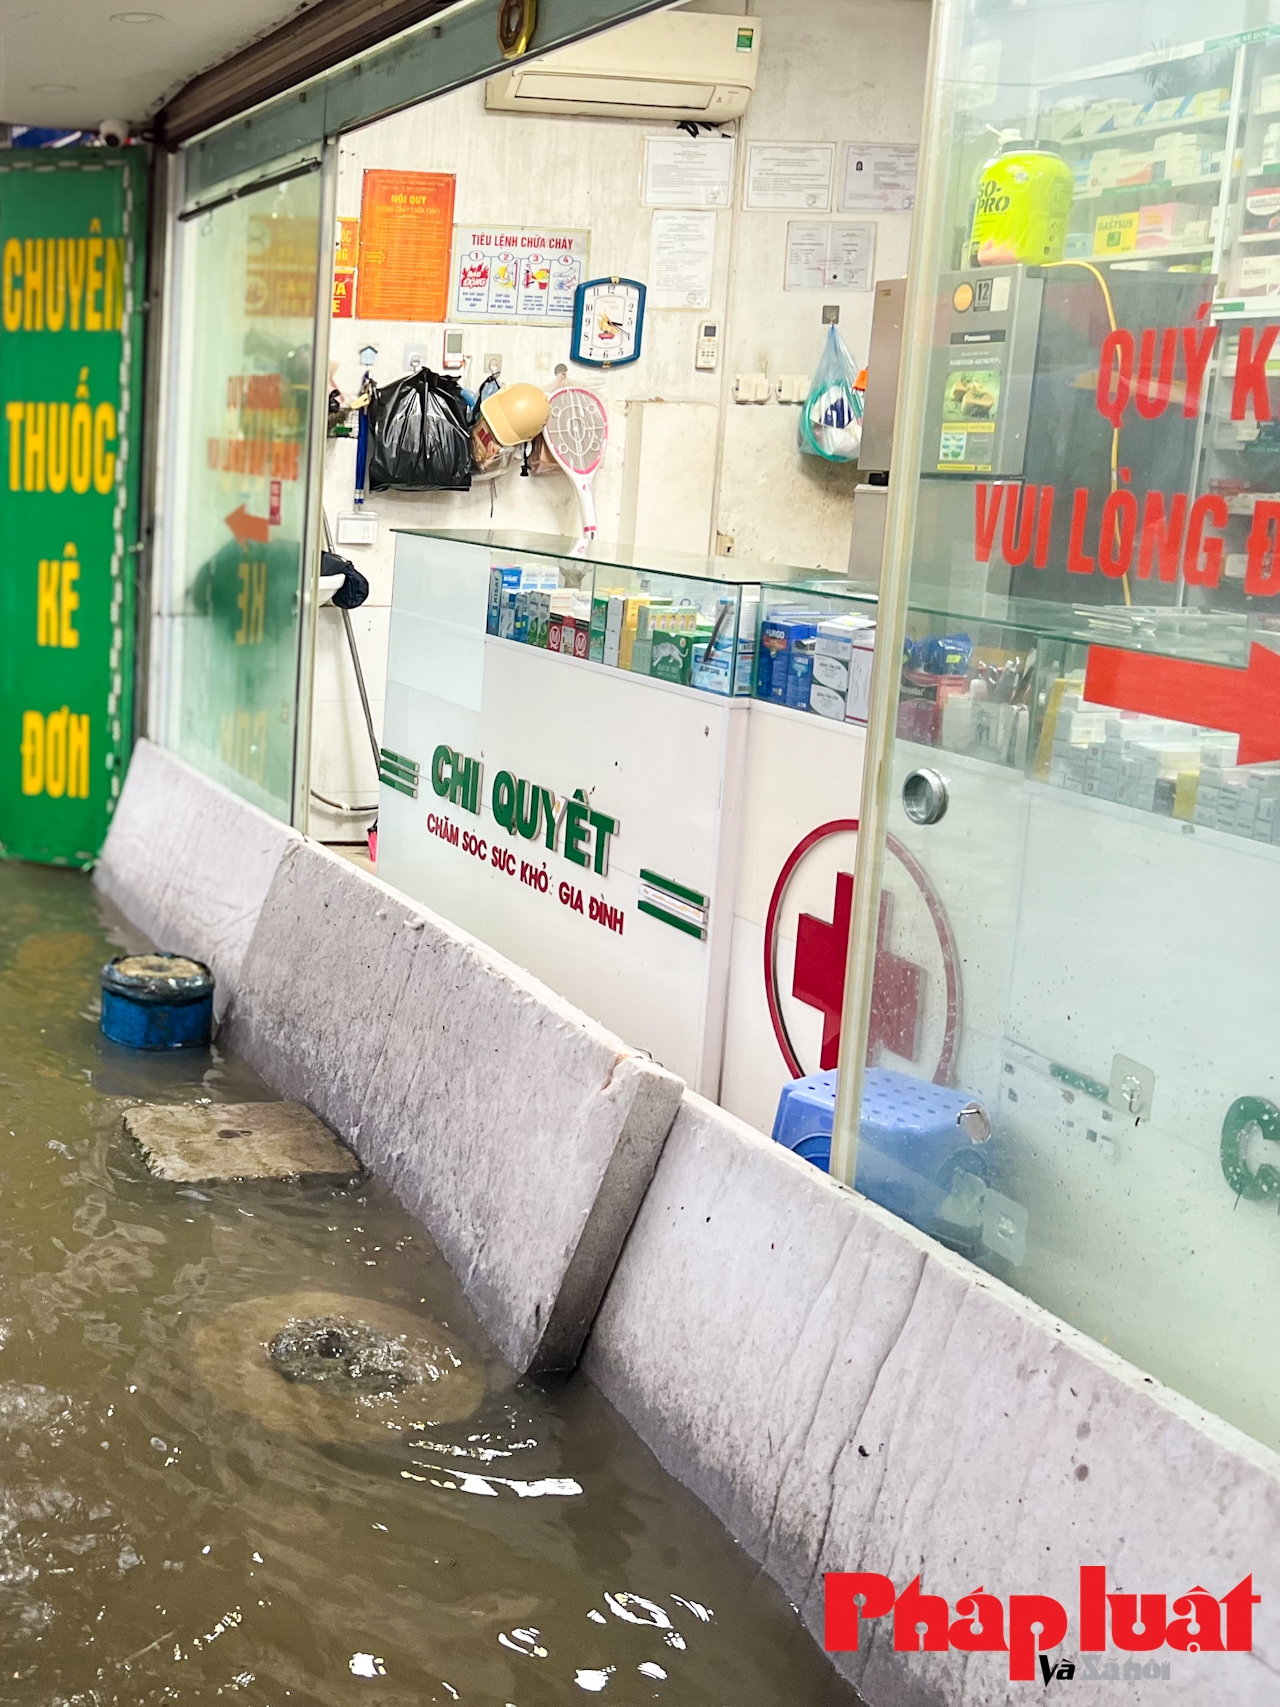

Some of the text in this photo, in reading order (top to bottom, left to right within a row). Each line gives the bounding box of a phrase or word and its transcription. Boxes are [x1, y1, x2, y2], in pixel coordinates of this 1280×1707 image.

[391, 194, 427, 205] NỘI QUY
[471, 234, 574, 250] TIÊU LỆNH CHỮA CHÁY
[2, 218, 125, 332] CHUYÊN
[607, 285, 616, 295] 12
[978, 282, 990, 301] 12
[585, 303, 593, 312] 10
[628, 303, 634, 313] 2
[585, 318, 591, 327] 9
[583, 332, 589, 341] 8
[603, 350, 608, 359] 6
[1096, 301, 1220, 429] QUÝ
[5, 366, 117, 495] THUỐC
[973, 483, 1055, 570] VUI
[1067, 467, 1228, 589] LÒNG
[36, 541, 81, 649] KÊ
[20, 705, 91, 799] ĐƠN
[427, 813, 459, 848] CHĂM
[558, 881, 584, 915] GIA
